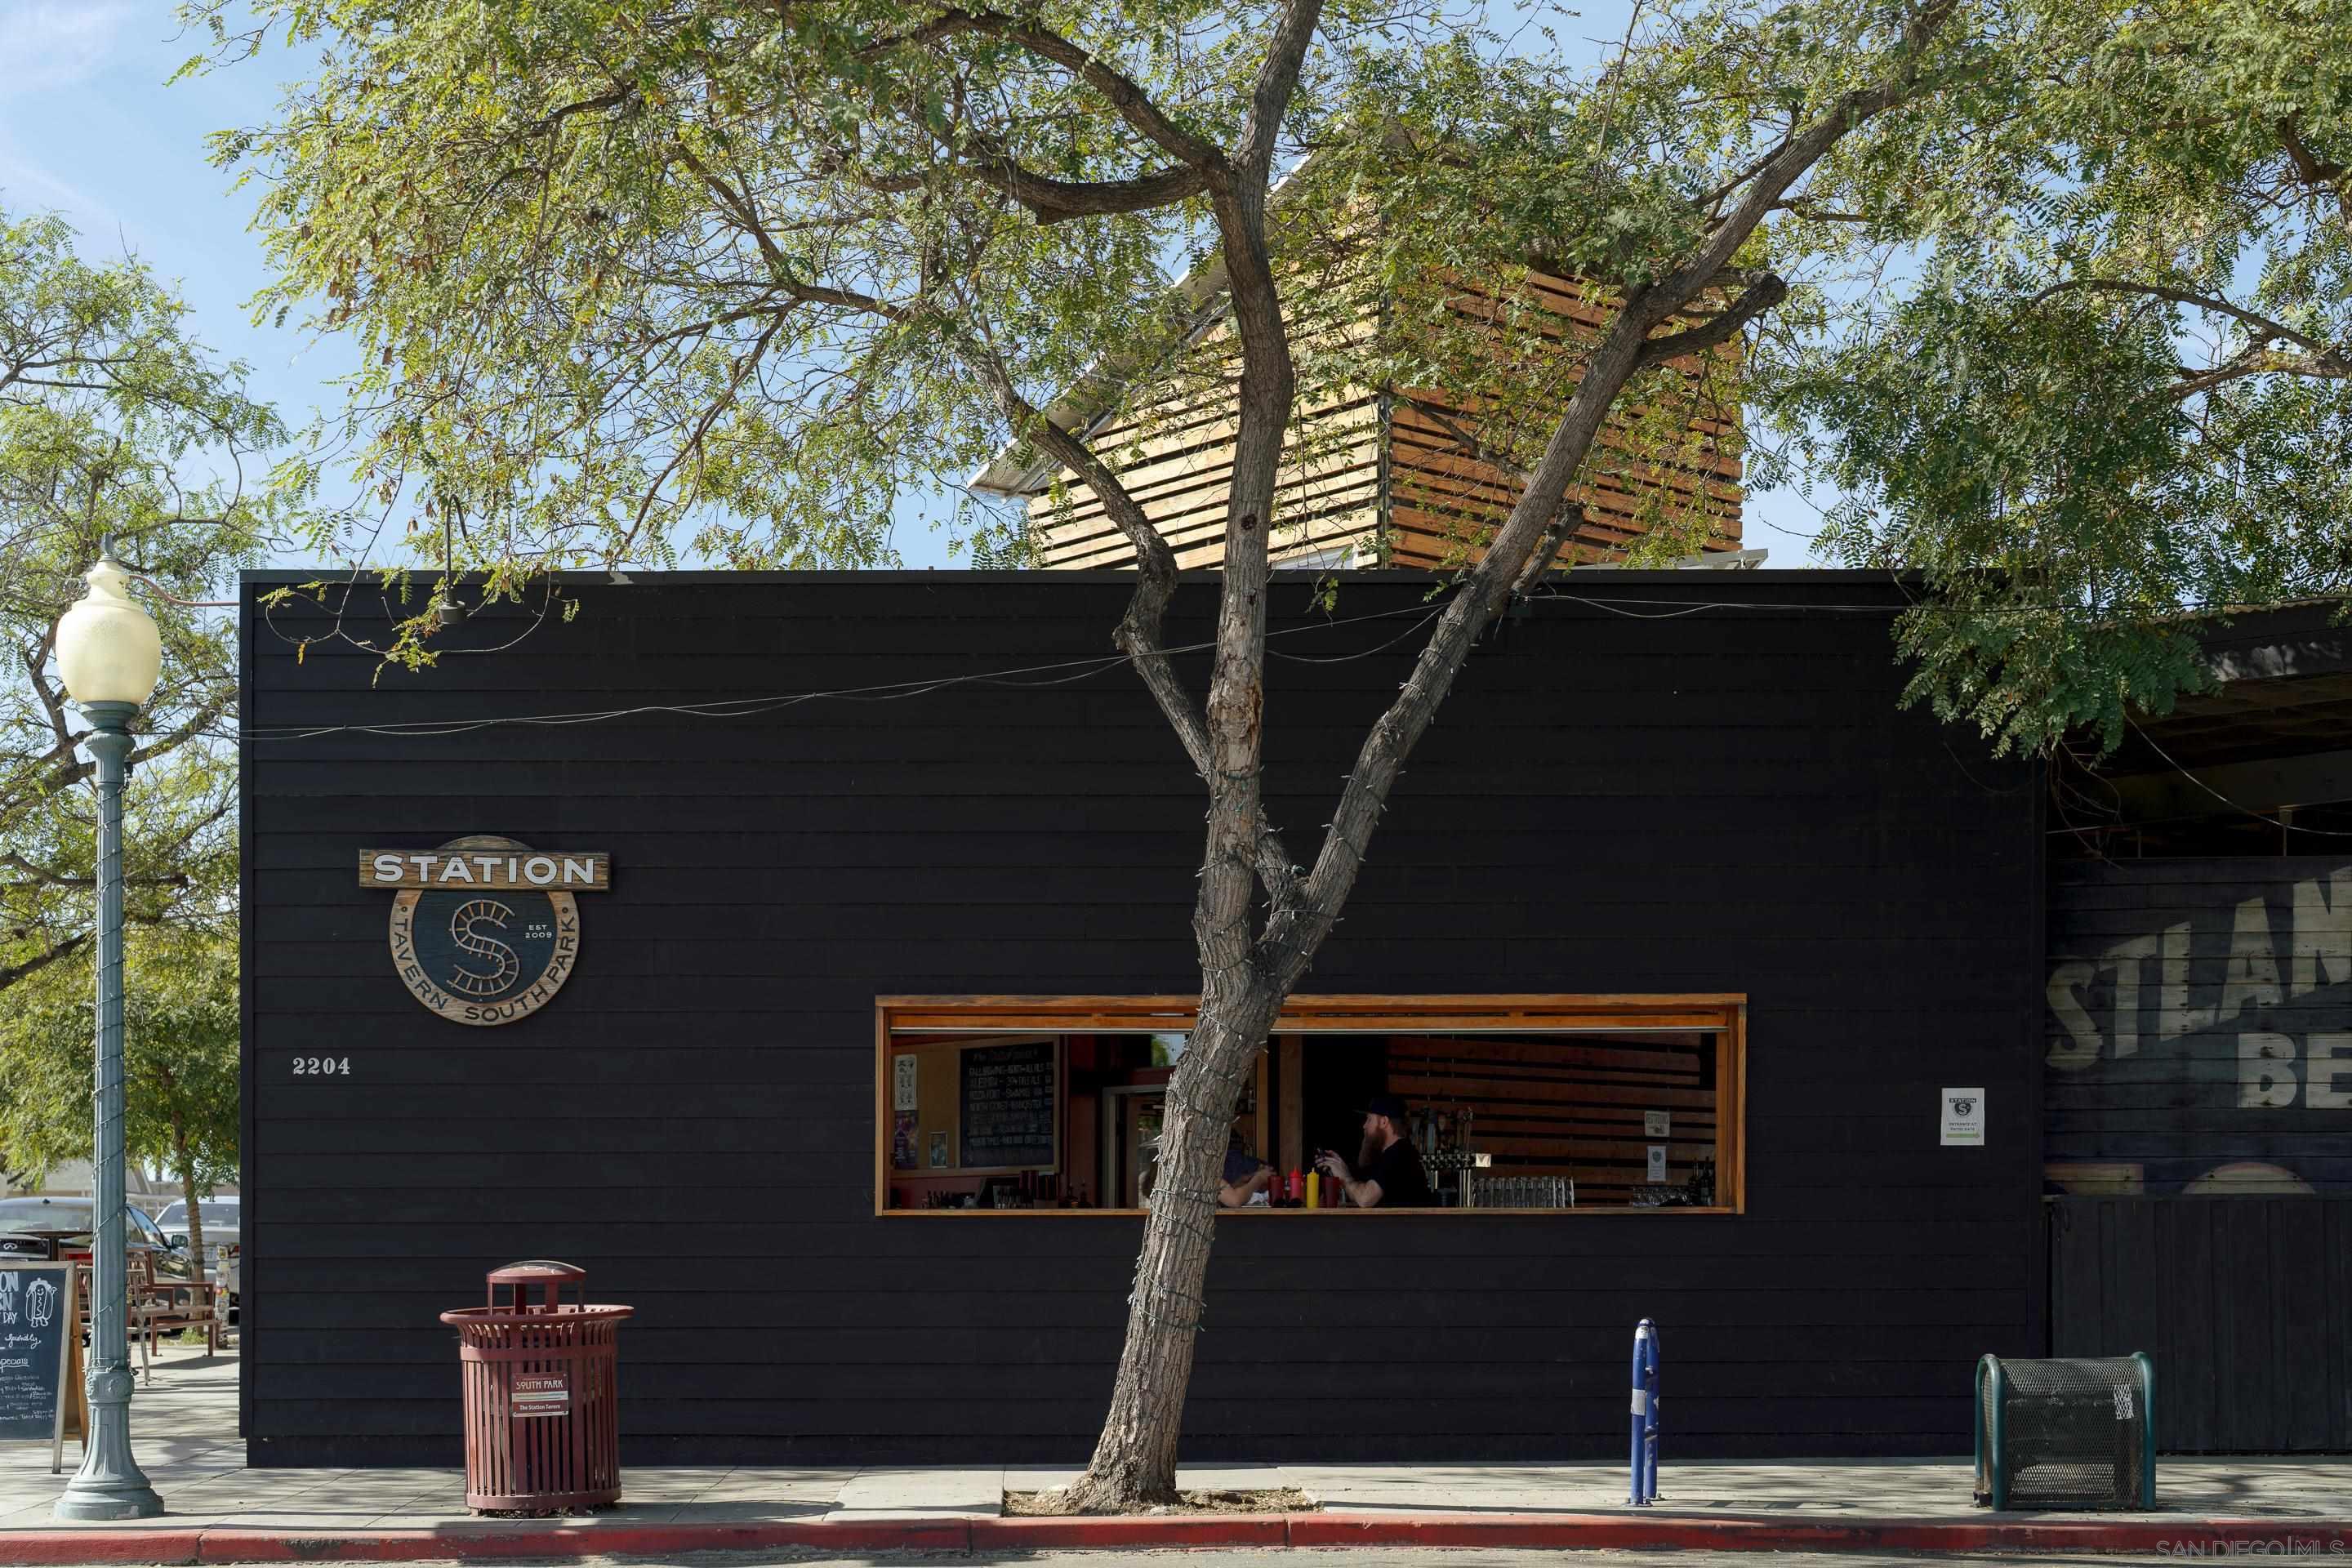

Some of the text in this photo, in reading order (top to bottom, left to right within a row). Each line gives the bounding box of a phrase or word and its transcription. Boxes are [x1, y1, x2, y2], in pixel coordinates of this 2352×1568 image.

[372, 853, 595, 885] STATION
[525, 931, 553, 939] 2009
[394, 915, 576, 1022] TAVERN SOUTH PARK
[292, 1057, 350, 1075] 2204
[3, 1312, 17, 1325] DAY
[0, 1357, 28, 1373] pecials
[516, 1379, 564, 1390] SOUTH PARK
